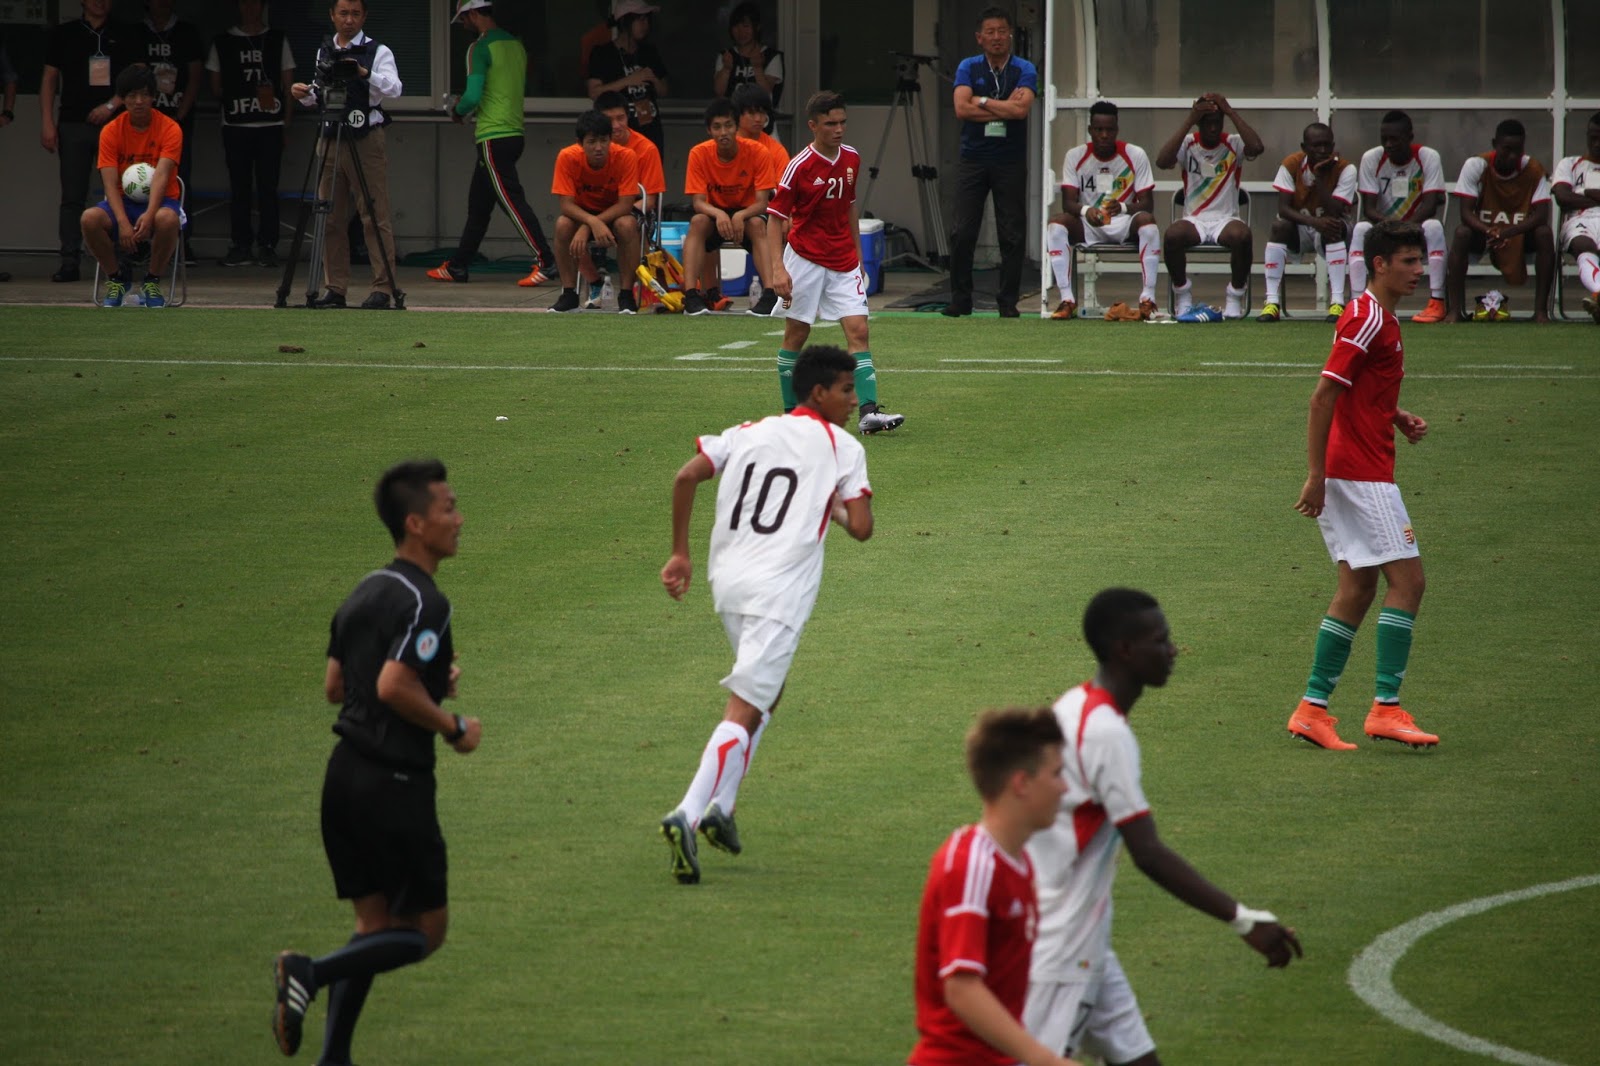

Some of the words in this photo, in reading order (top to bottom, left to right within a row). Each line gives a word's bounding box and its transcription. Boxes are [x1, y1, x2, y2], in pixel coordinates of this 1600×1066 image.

[148, 43, 172, 57] HB
[240, 50, 263, 63] HB
[243, 69, 262, 82] 71
[826, 176, 844, 200] 21
[1080, 174, 1097, 192] 14
[1381, 177, 1391, 194] 7
[1479, 209, 1526, 225] CAF
[729, 461, 799, 535] 10
